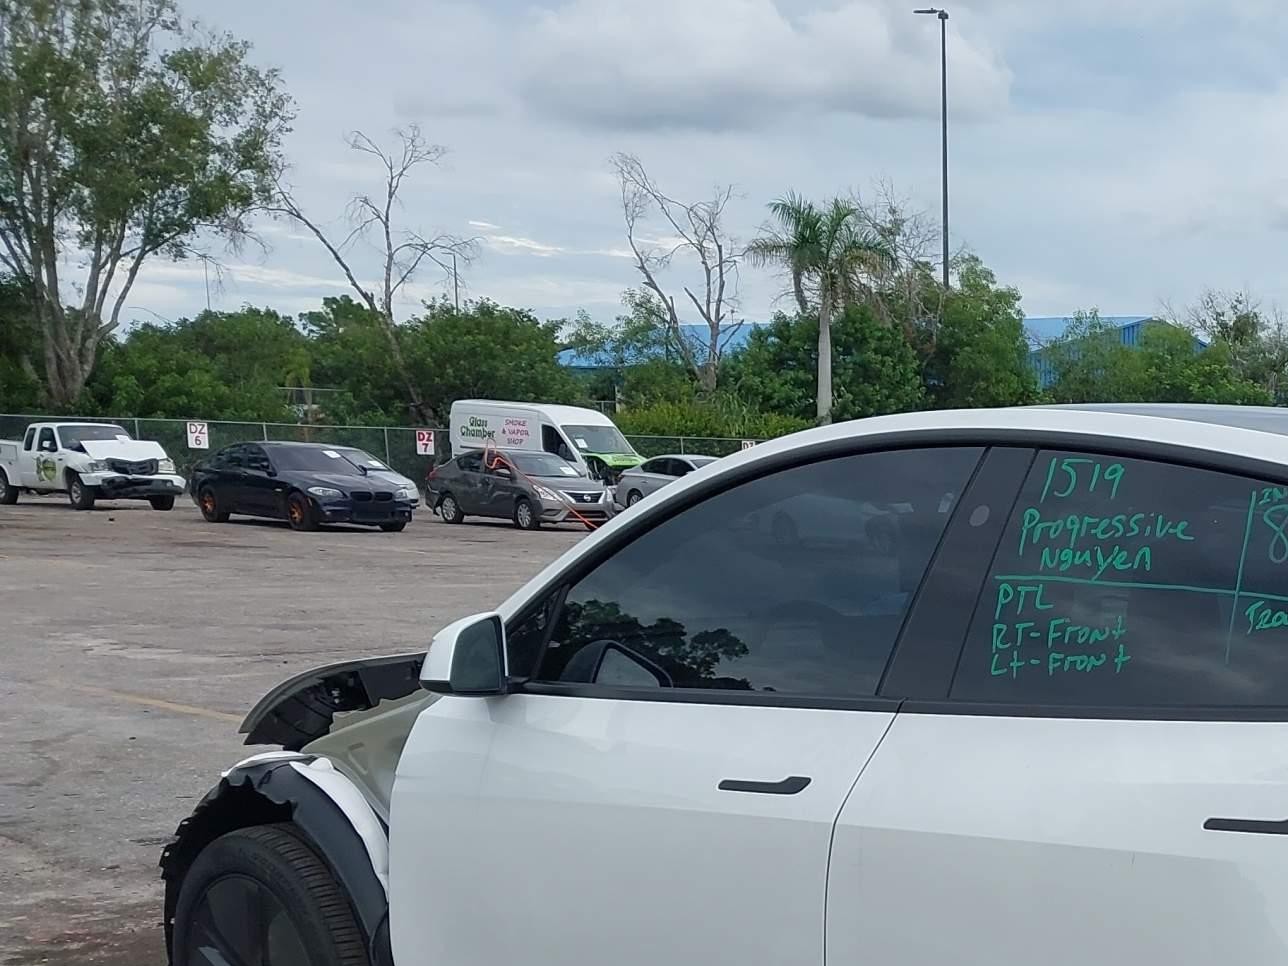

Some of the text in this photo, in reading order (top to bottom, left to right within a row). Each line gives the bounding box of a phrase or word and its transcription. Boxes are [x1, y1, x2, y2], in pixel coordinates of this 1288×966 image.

[468, 416, 488, 428] Glass
[189, 423, 206, 435] DZ
[460, 425, 496, 440] Chamber
[194, 435, 202, 446] 6
[417, 431, 433, 442] DZ
[422, 443, 429, 452] 7
[1040, 457, 1125, 503] 1519
[1019, 508, 1195, 556] Progressive
[994, 583, 1054, 620] PTL
